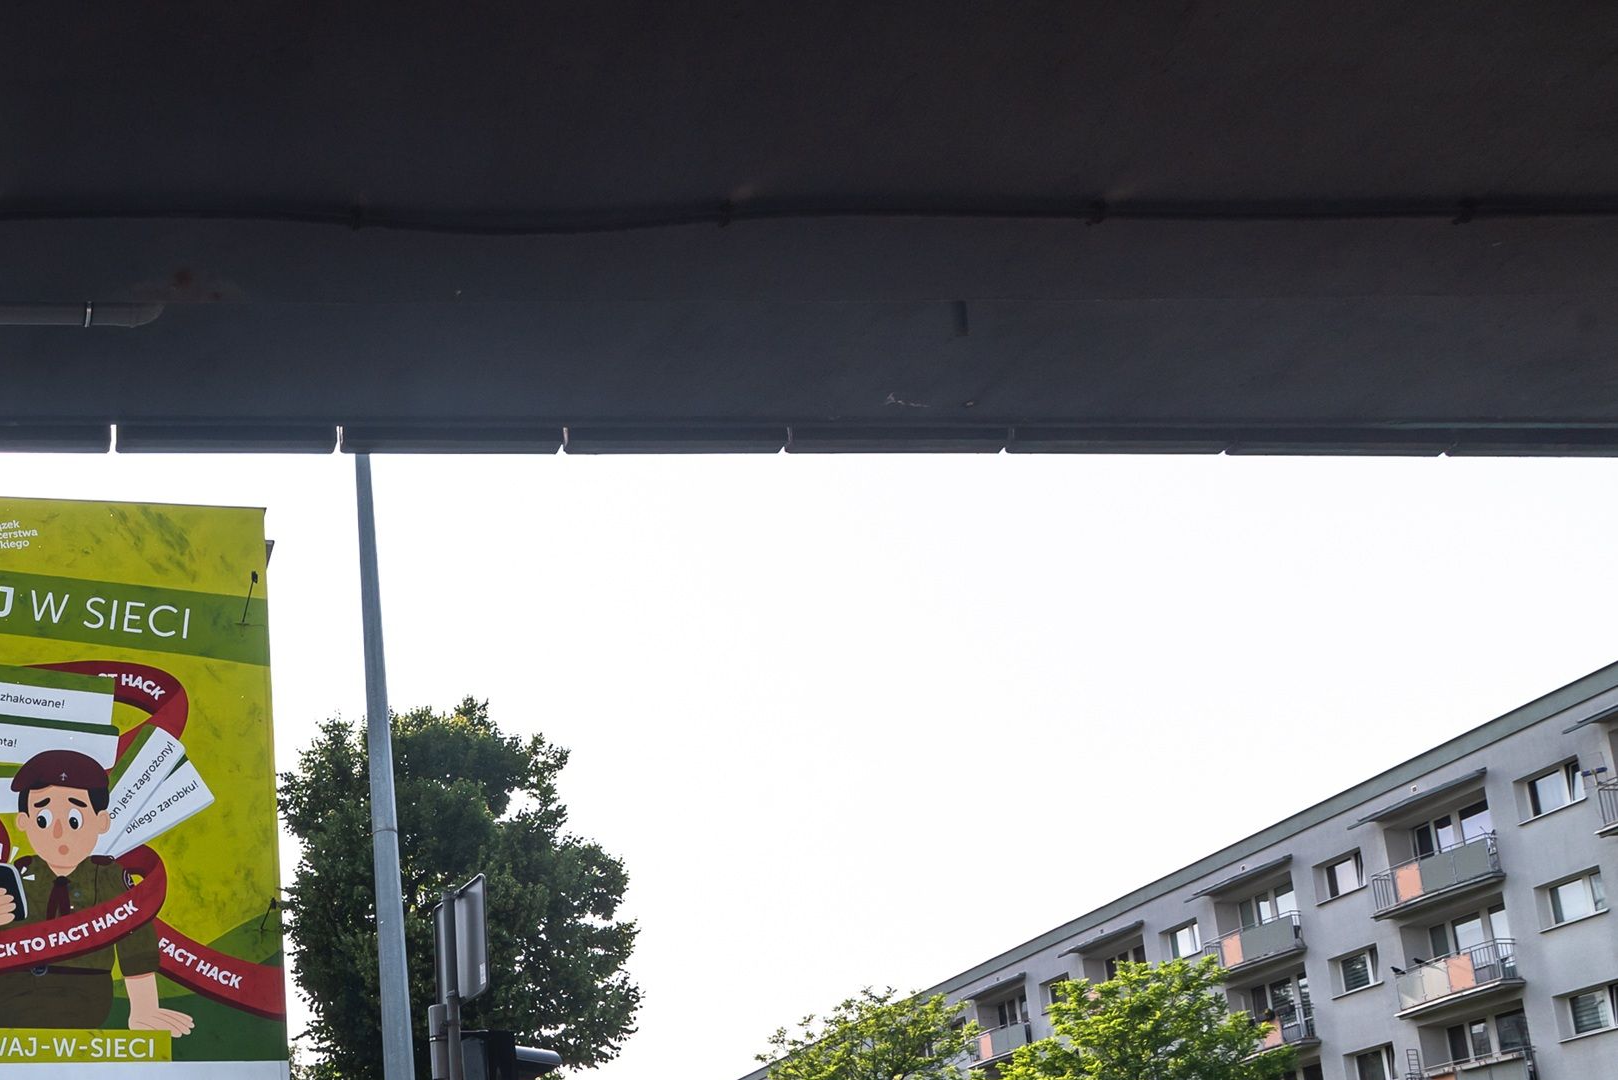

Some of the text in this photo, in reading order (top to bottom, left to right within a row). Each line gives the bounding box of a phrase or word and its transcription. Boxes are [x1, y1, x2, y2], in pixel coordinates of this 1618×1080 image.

[30, 589, 70, 624] W
[83, 597, 190, 640] SIECI
[0, 691, 65, 709] zhakowane!
[120, 672, 166, 701] HACK
[119, 789, 137, 811] jest
[132, 740, 177, 792] zagrożony!
[156, 779, 200, 813] zarobku!
[19, 936, 47, 954] TO
[48, 923, 90, 948] FACT
[91, 899, 139, 933] HACK
[158, 937, 243, 990] FACT HACK
